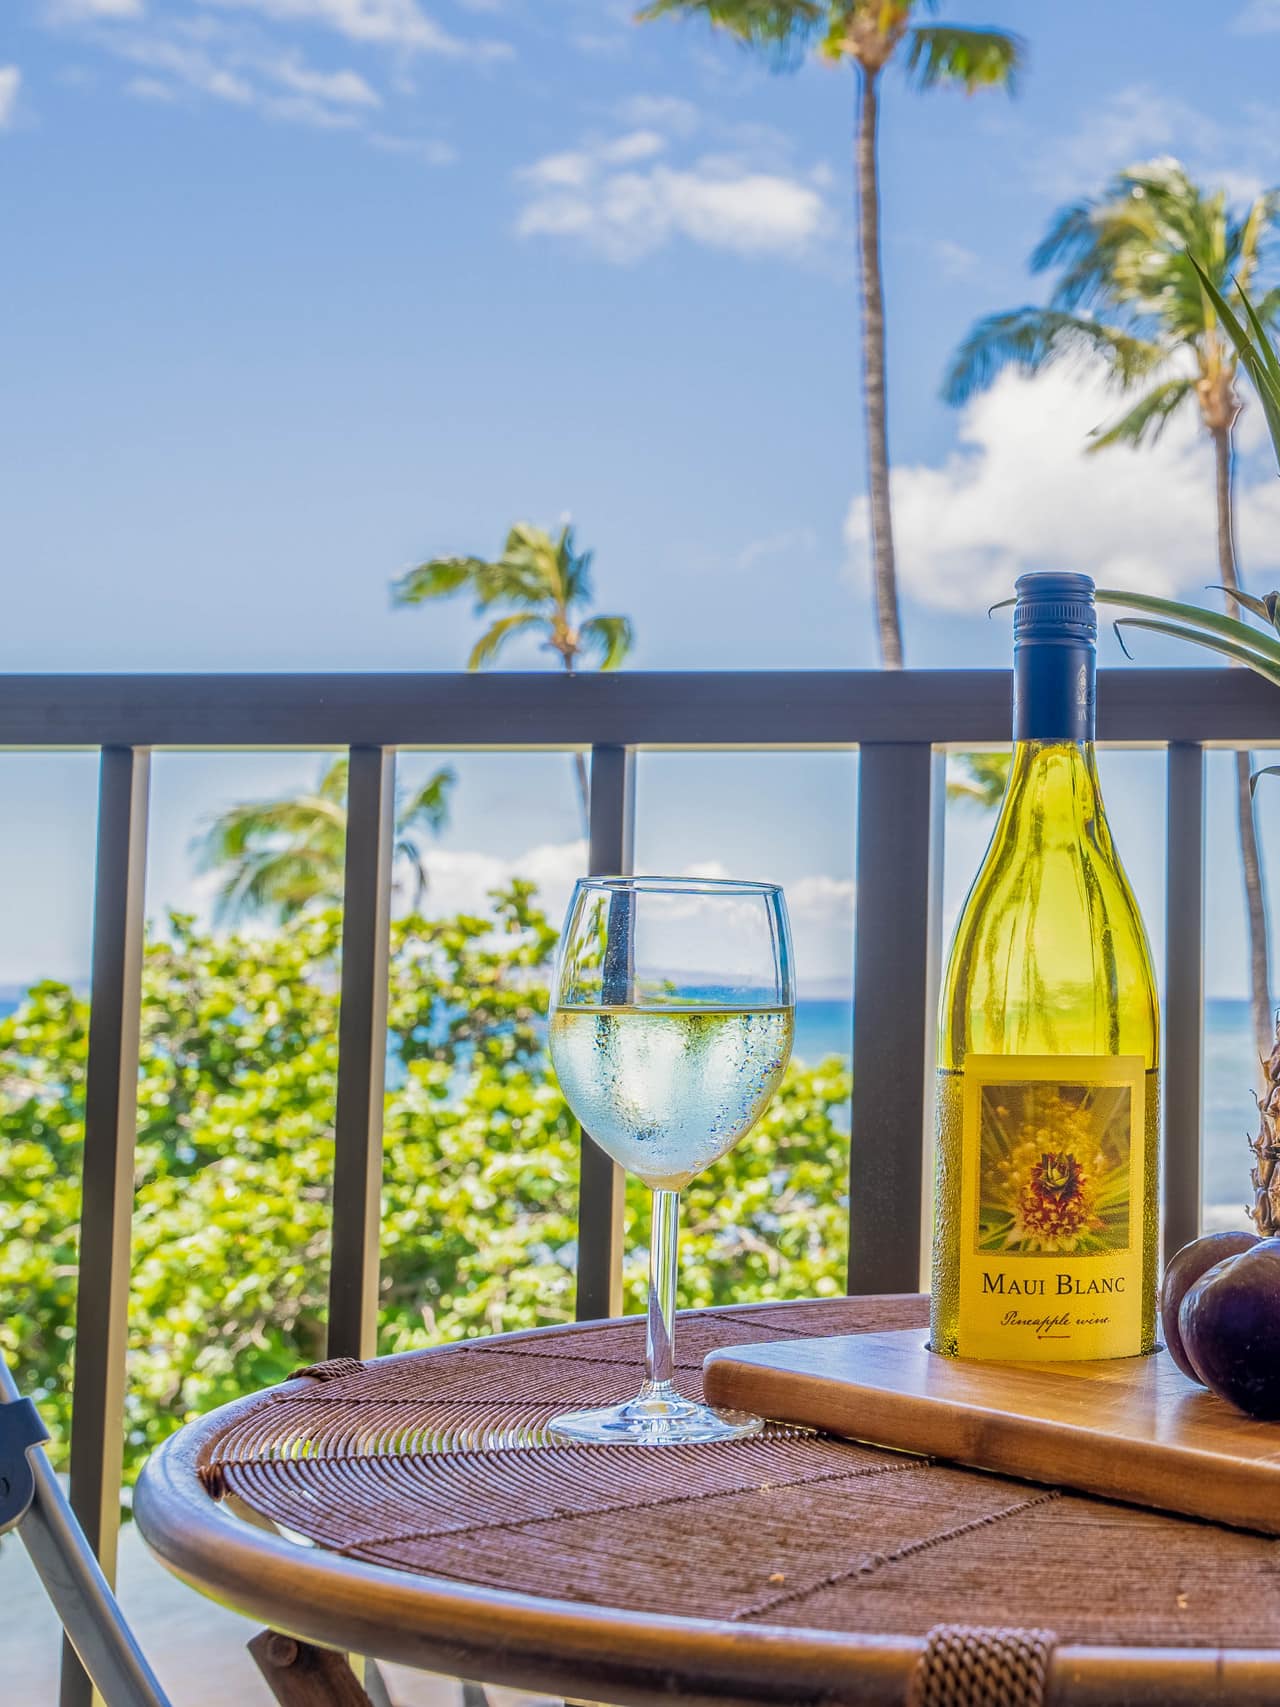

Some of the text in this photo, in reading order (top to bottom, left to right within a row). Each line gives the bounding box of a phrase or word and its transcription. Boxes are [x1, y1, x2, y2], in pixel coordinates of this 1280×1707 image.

[982, 1272, 1126, 1296] MAUI BLANC
[1000, 1310, 1110, 1333] Pineapple wine
